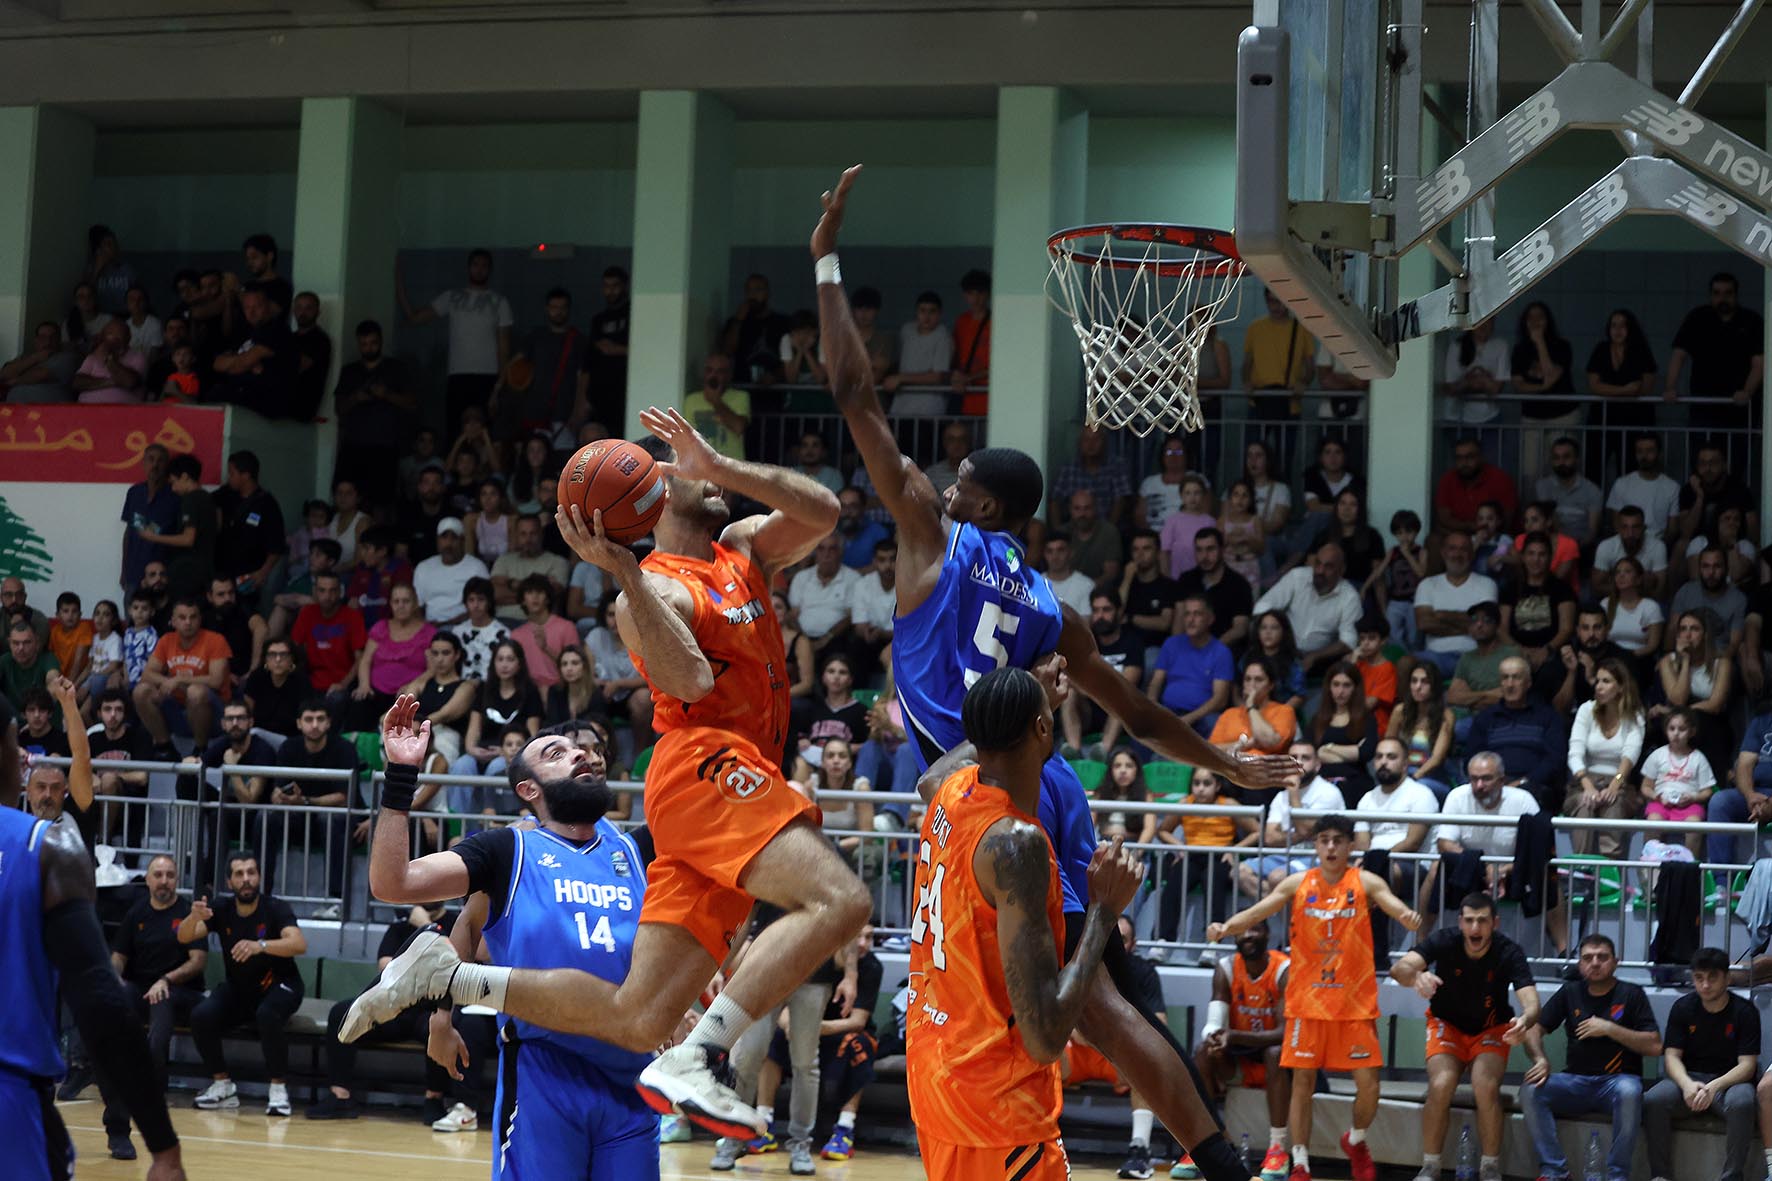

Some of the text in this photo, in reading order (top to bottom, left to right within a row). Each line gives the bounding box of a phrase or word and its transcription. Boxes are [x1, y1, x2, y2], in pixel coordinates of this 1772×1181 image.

[963, 600, 1021, 692] 5
[726, 765, 766, 798] 21
[553, 878, 633, 911] HOOPS
[911, 840, 946, 971] 24
[574, 911, 616, 953] 14
